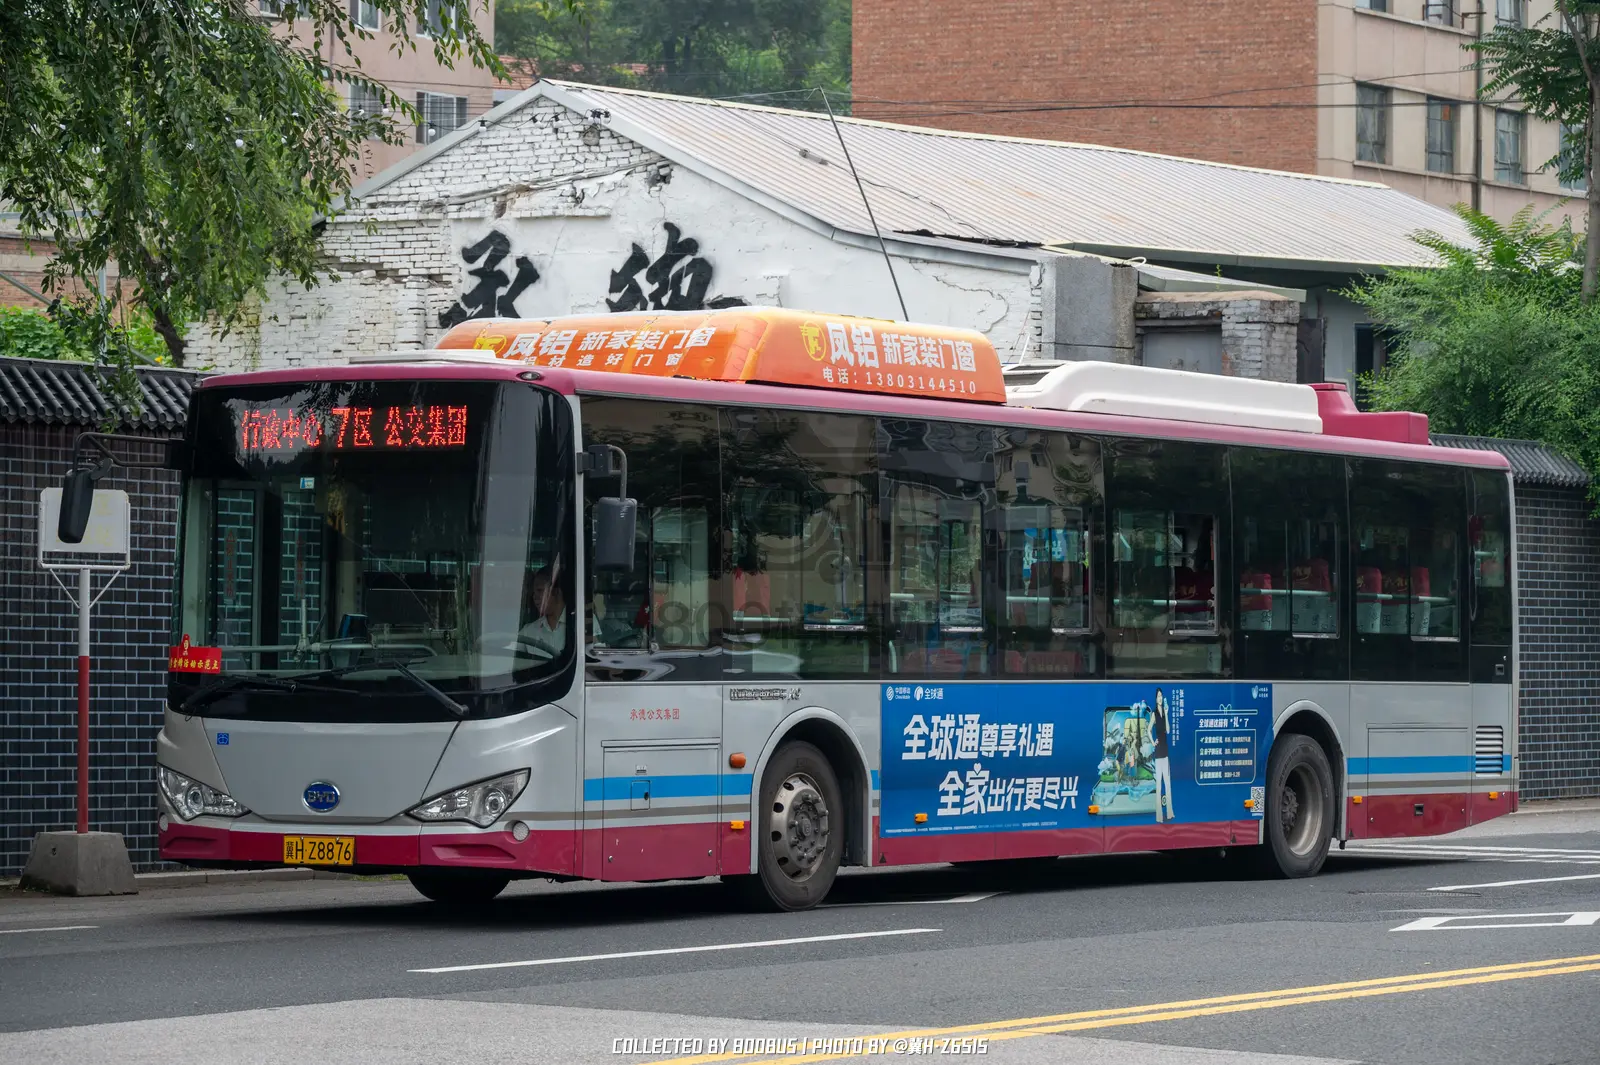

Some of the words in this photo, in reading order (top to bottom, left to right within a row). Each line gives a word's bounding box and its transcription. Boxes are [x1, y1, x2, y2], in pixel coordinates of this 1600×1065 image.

[503, 329, 578, 358] 凤铝
[577, 327, 716, 351] 新家装门窗
[826, 321, 880, 369] 凤铝
[881, 332, 977, 372] 新家装门窗
[242, 407, 322, 449] 行政中心
[384, 405, 467, 447] 公交集团
[924, 688, 944, 700] 全球通
[630, 708, 680, 720] 承德公交集团
[902, 713, 1054, 760] 全球通尊享礼遇
[307, 790, 336, 803] BYD
[937, 764, 1079, 816] 全家出行更尽兴
